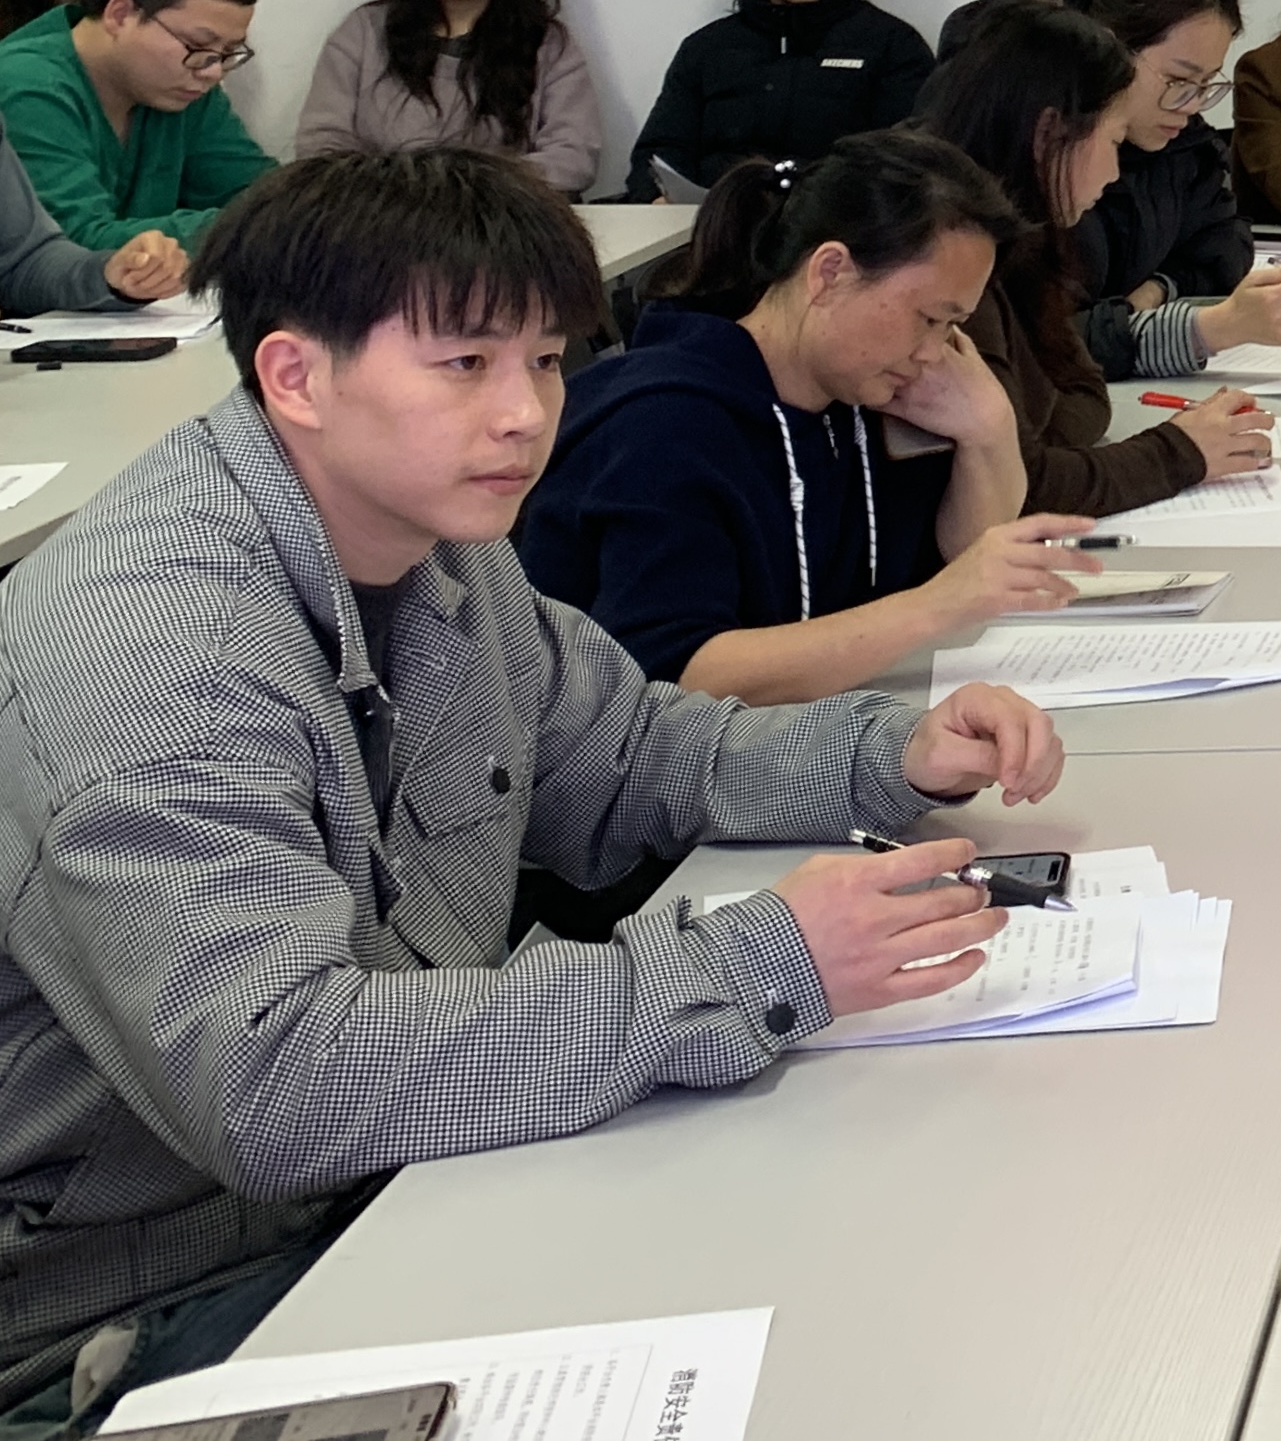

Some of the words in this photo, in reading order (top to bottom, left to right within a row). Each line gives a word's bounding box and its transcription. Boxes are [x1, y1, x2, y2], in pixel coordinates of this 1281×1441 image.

[655, 1367, 699, 1441] 消防安全责
